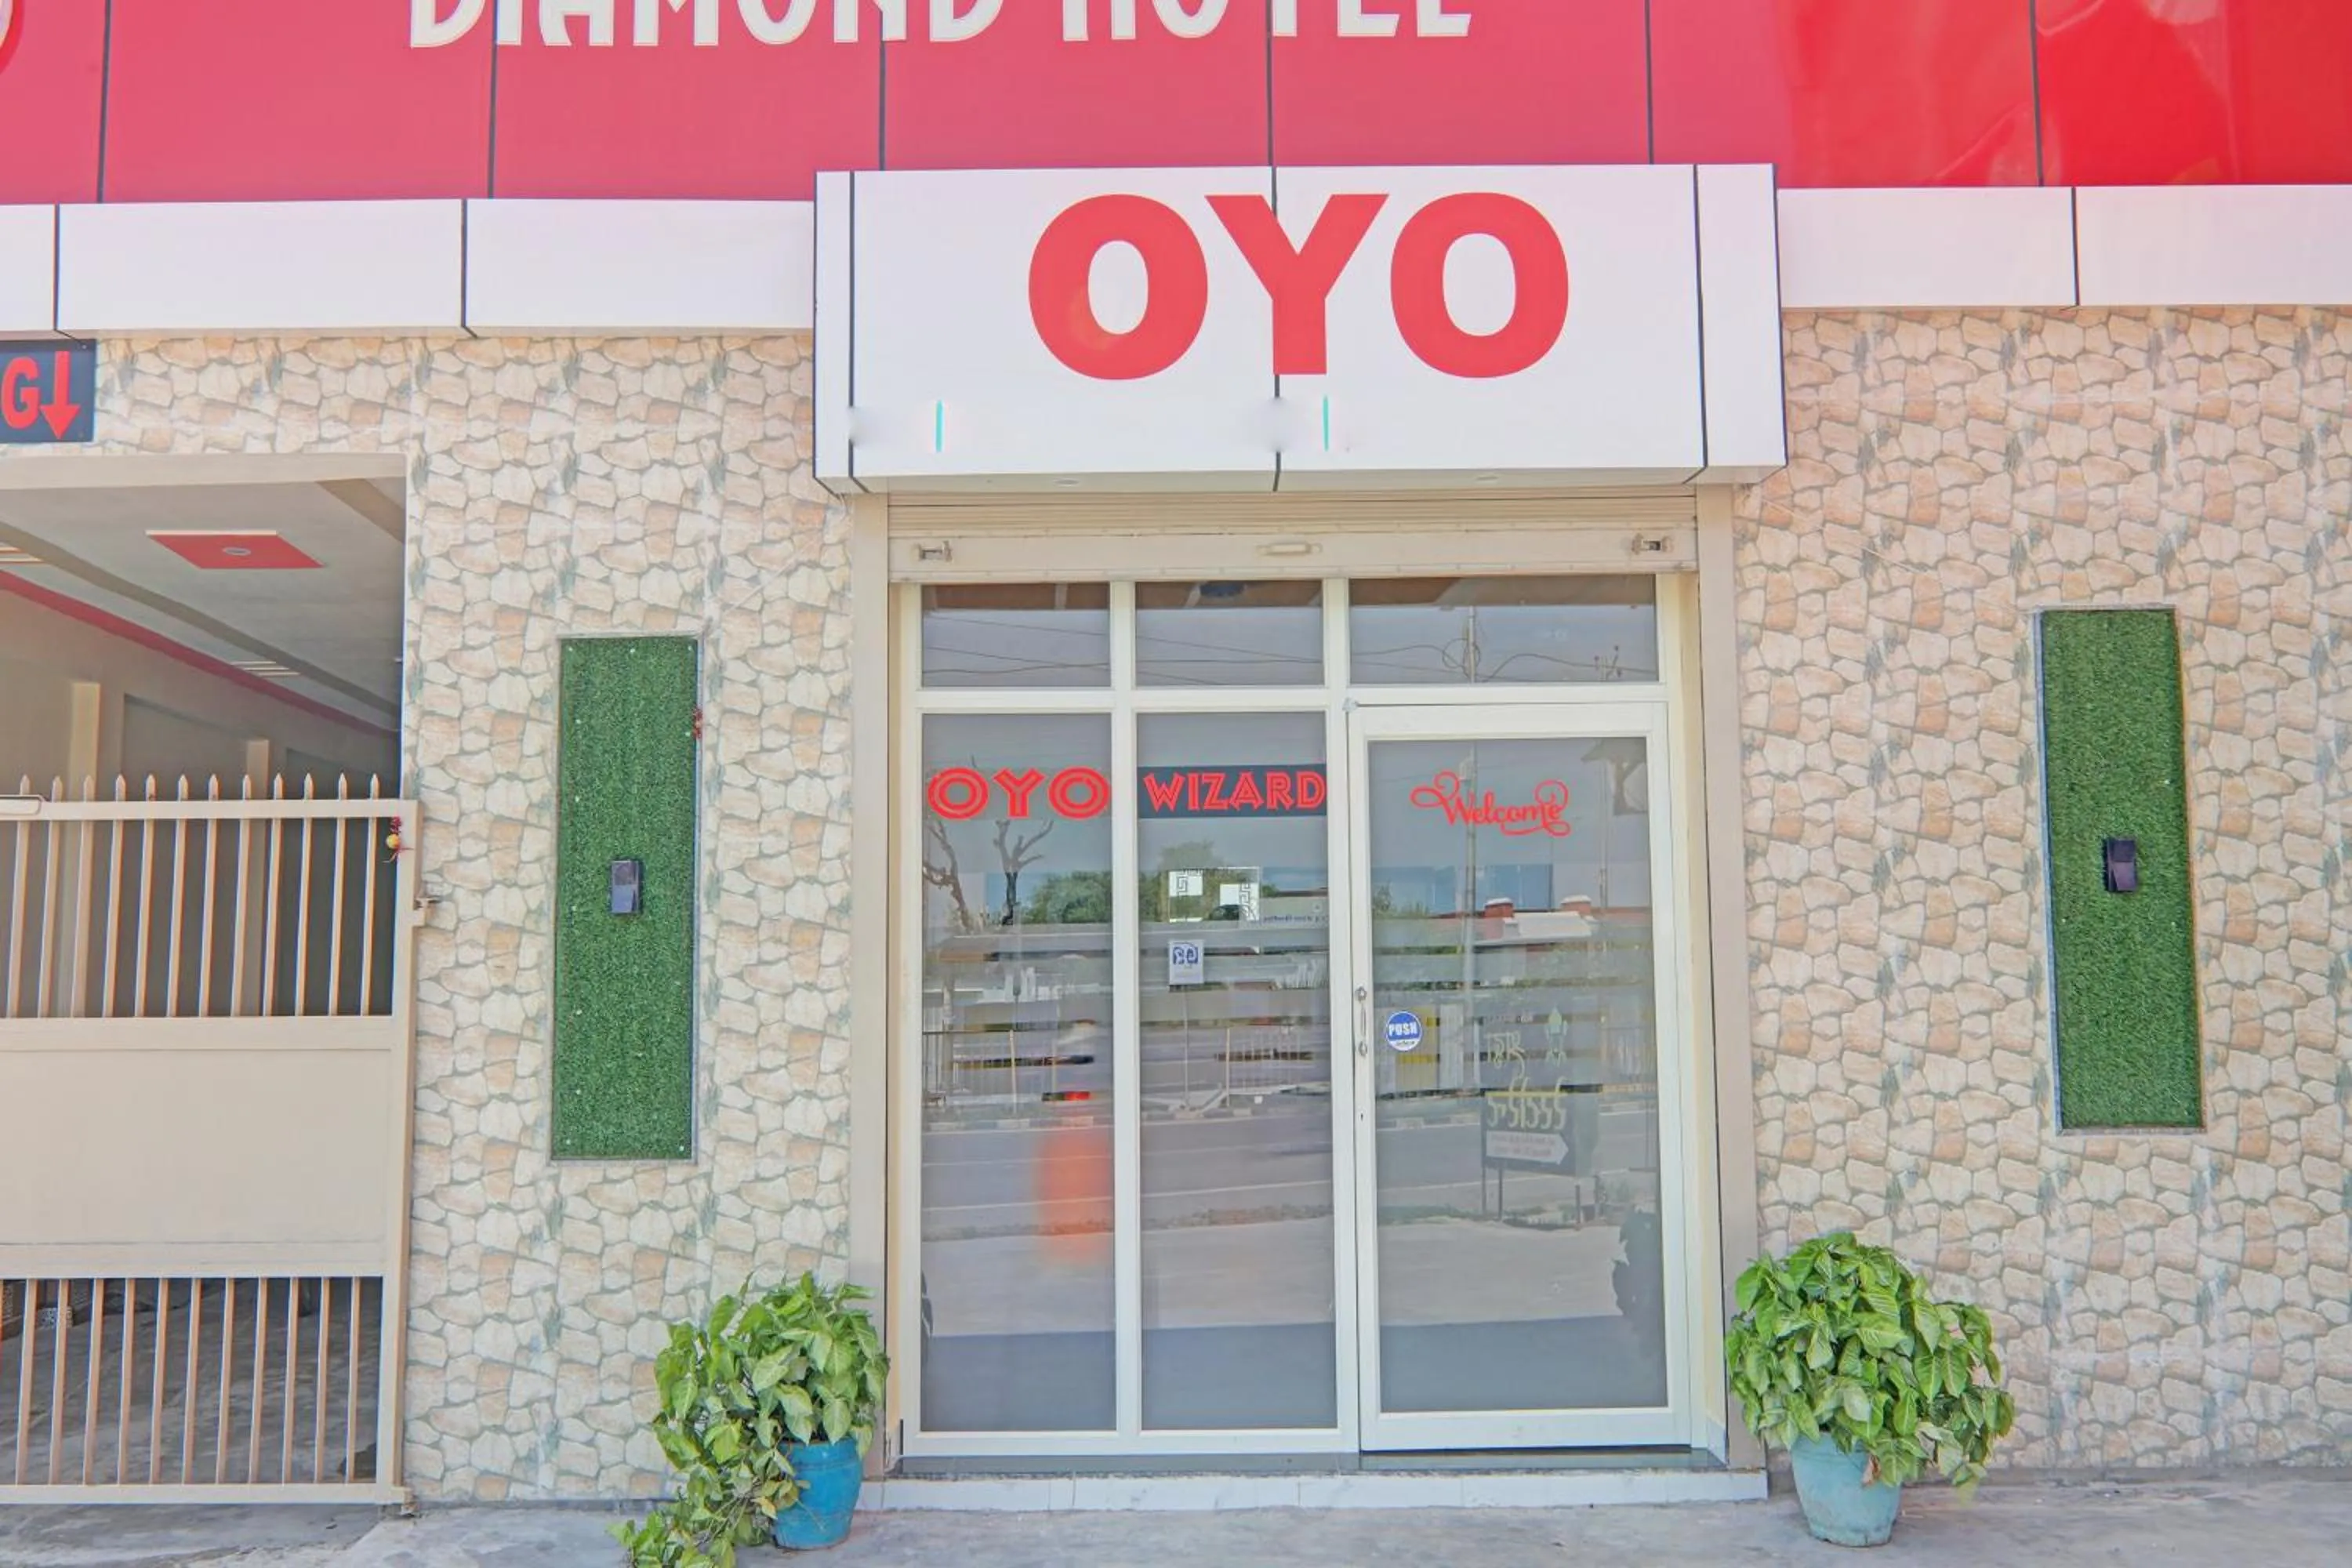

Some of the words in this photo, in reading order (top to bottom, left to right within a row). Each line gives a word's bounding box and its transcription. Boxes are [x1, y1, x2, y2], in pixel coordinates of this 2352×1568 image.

[1028, 192, 1569, 380] OYO
[927, 768, 1112, 819] OYO
[1143, 771, 1325, 812] WIZARD
[1410, 771, 1571, 837] Welcome
[1388, 1022, 1417, 1036] PUSH
